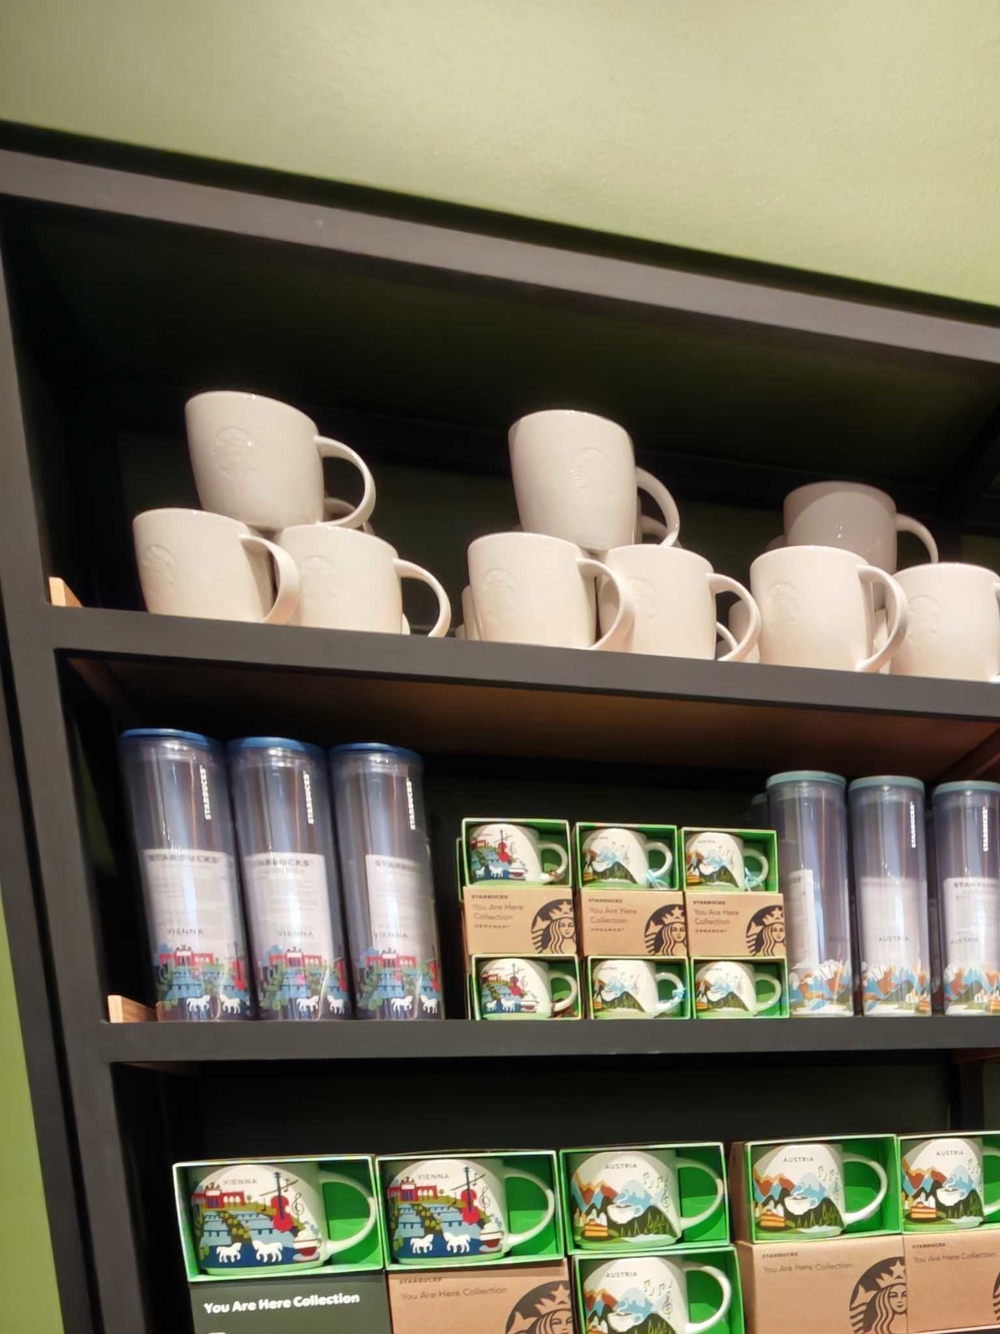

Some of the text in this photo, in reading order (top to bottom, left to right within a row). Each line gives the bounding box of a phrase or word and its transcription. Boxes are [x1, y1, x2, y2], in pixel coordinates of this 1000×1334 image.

[200, 765, 212, 820] STARBUCKS
[303, 771, 315, 825] STARBUCKS
[406, 777, 416, 831] STARBUCKS
[909, 801, 917, 848] STARBUCKS
[223, 1178, 258, 1186] VIENNA
[204, 1293, 360, 1314] You Are Here Collection
